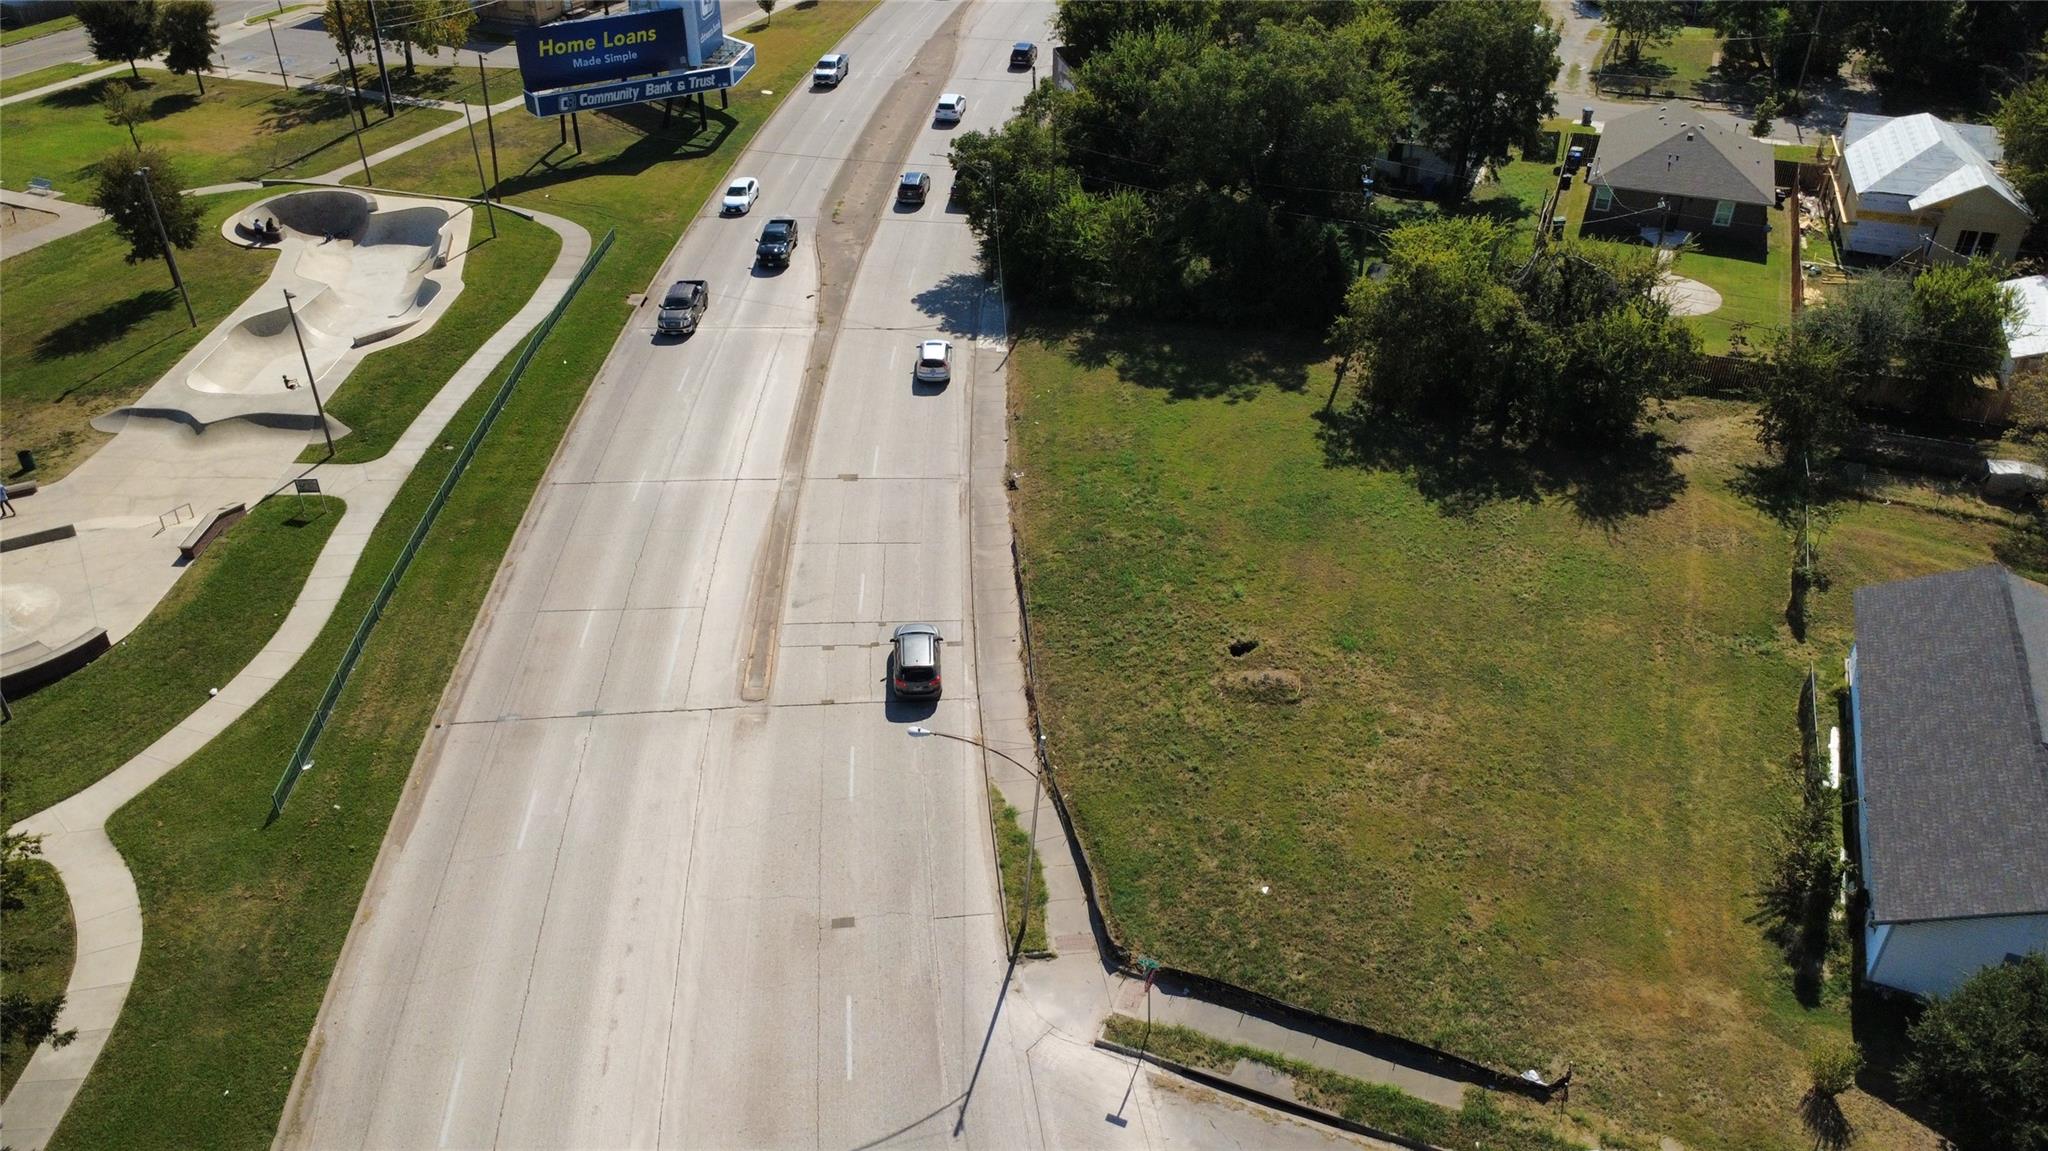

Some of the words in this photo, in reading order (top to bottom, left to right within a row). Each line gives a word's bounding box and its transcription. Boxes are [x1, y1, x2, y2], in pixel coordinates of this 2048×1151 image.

[539, 38, 596, 57] Home
[603, 28, 657, 48] Loans
[573, 57, 602, 68] Made
[604, 51, 638, 63] Simple
[580, 87, 639, 106] Community
[645, 80, 672, 96] Bank
[677, 80, 686, 91] &
[688, 74, 716, 89] Trust
